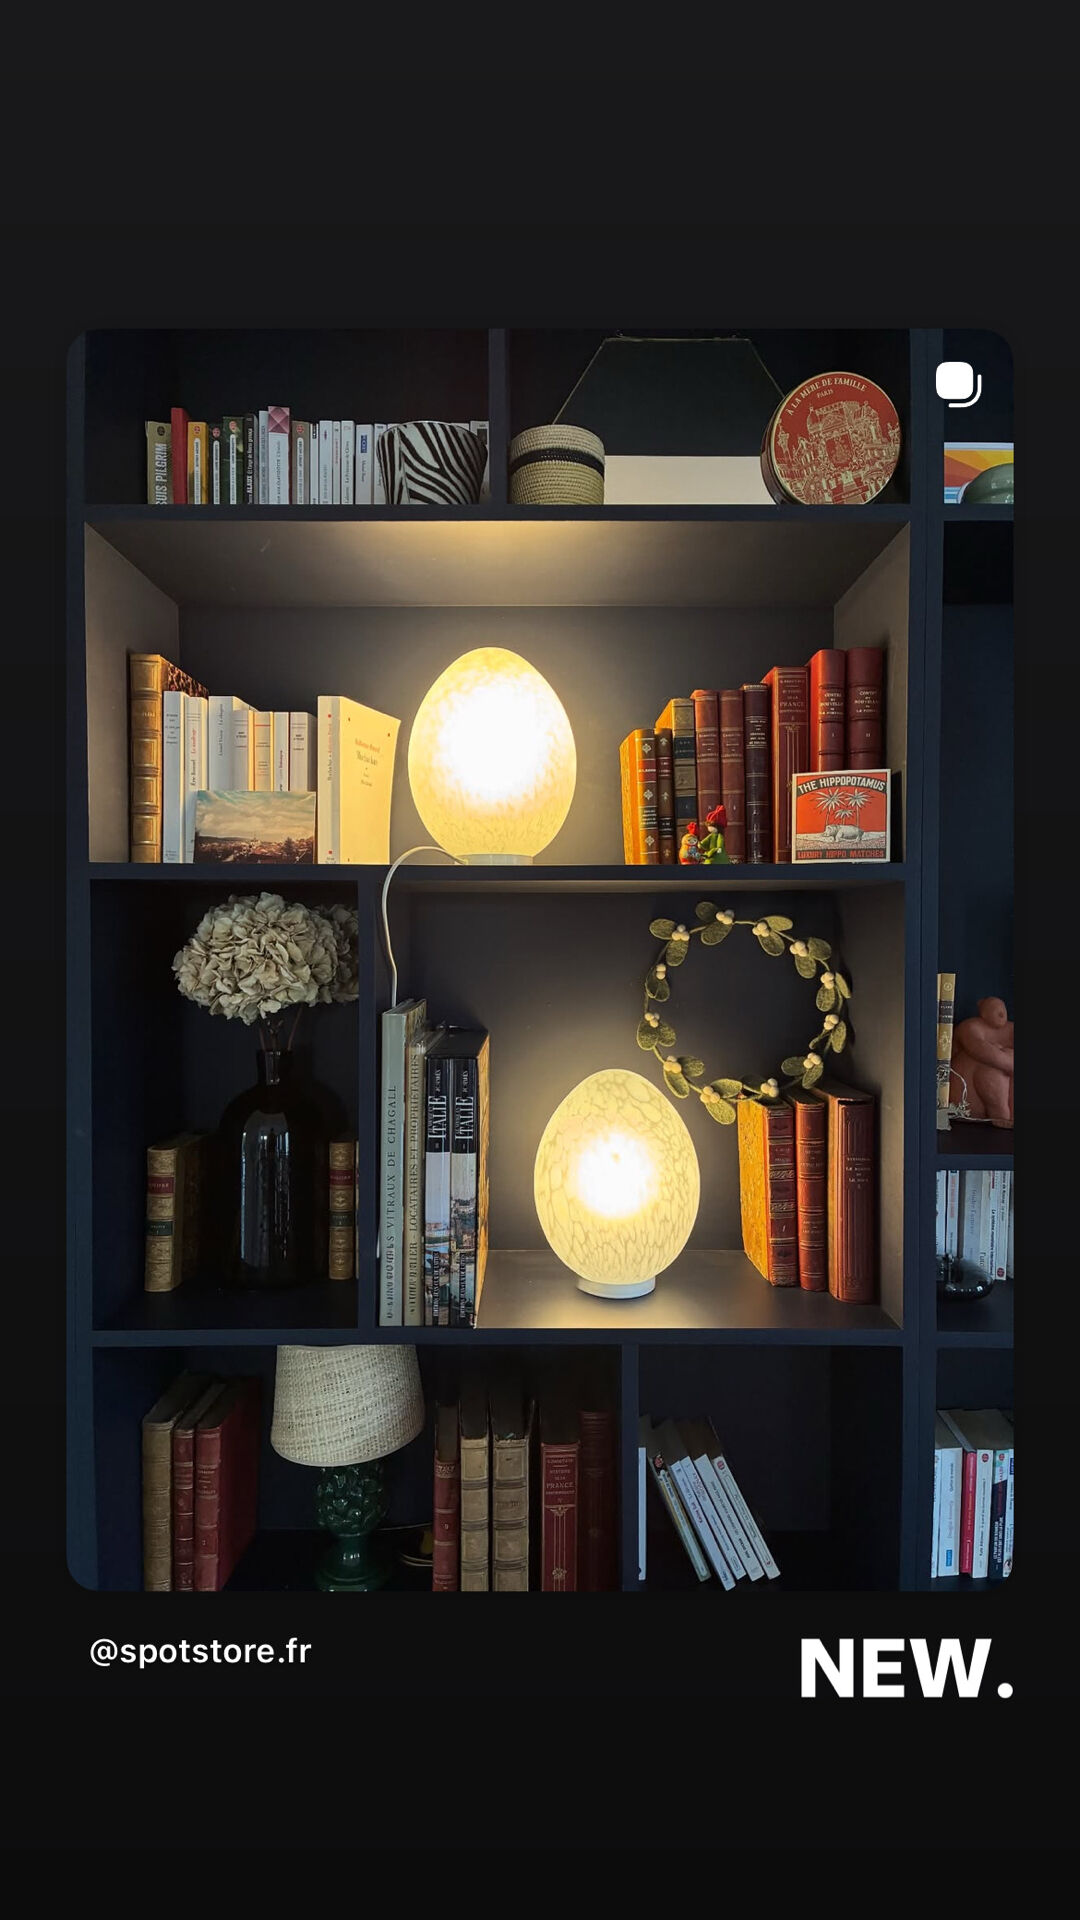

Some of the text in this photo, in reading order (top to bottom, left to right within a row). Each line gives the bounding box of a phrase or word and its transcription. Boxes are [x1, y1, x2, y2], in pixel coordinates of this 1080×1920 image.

[791, 398, 802, 408] LA
[822, 378, 833, 387] DE
[834, 377, 868, 392] FAMILLE
[816, 389, 834, 399] PARIS
[154, 442, 168, 482] PILGRIM
[798, 776, 886, 794] THE HIPPOPOTAMUS
[798, 850, 884, 858] LUXURY HIPPO MATCHES
[388, 1085, 397, 1144] CHAGALL
[428, 1095, 447, 1140] ITALIE
[455, 1096, 474, 1141] ITALIE
[387, 1151, 396, 1166] DE
[410, 1149, 418, 1160] ET
[386, 1174, 396, 1228] VITRAUX
[409, 1164, 418, 1232] LOCATAIRES
